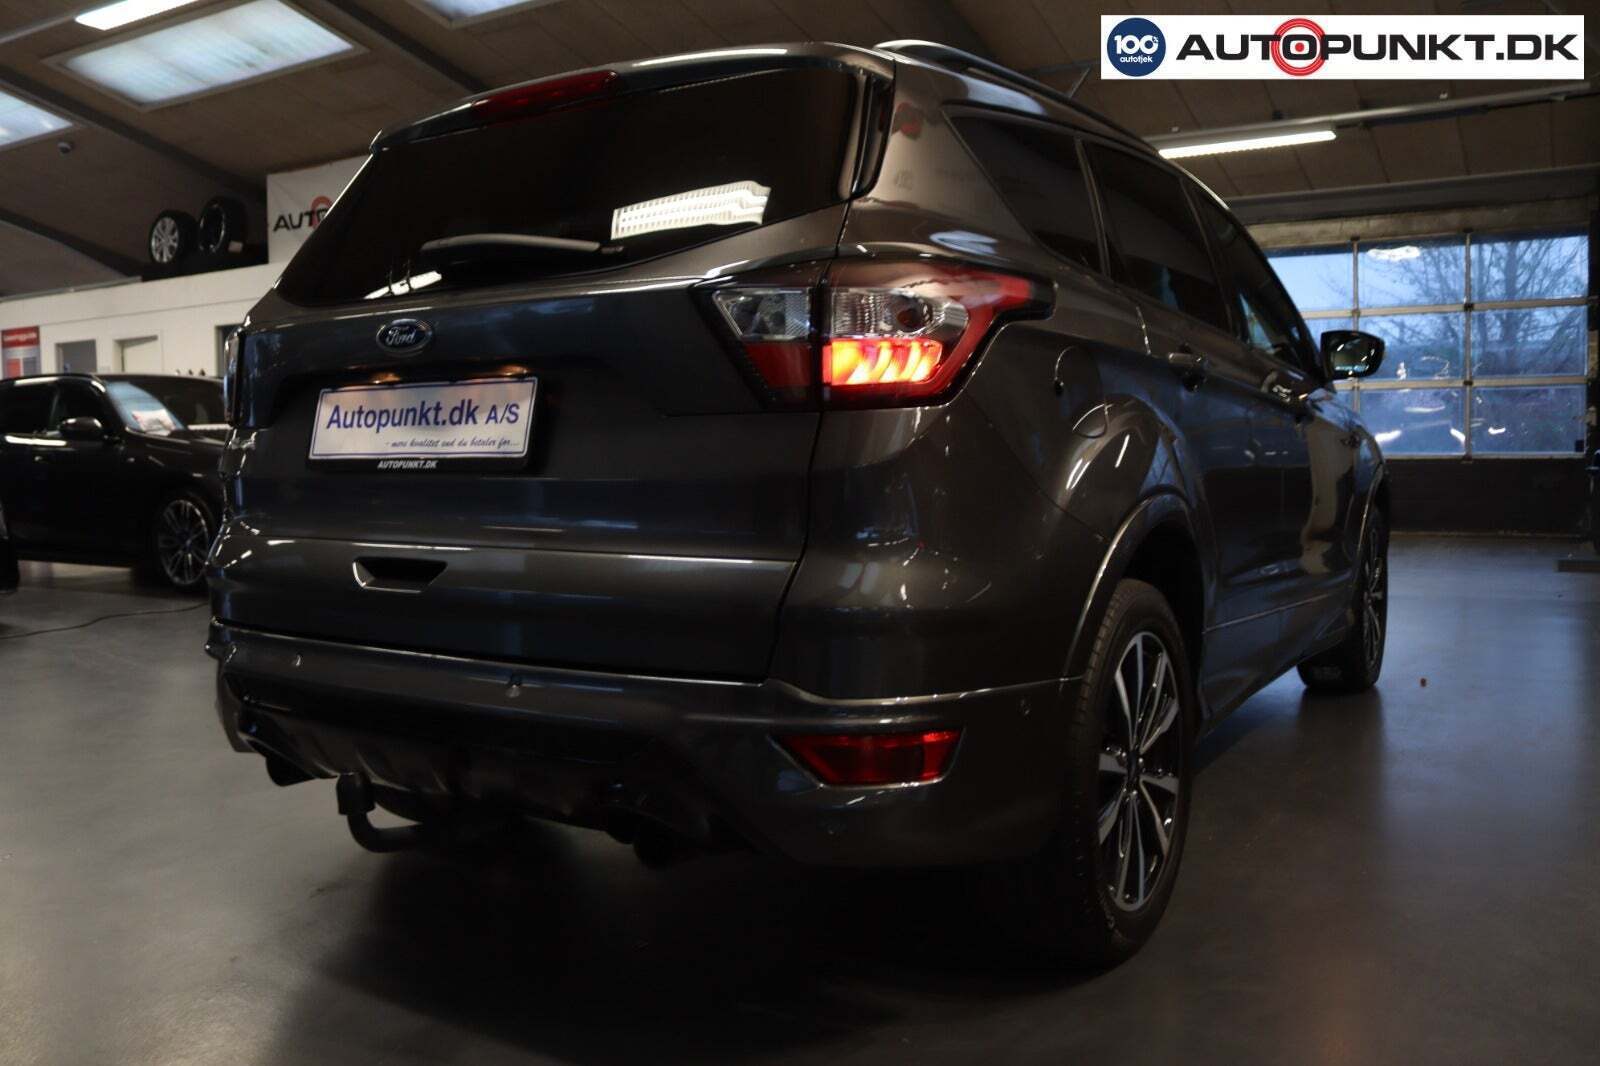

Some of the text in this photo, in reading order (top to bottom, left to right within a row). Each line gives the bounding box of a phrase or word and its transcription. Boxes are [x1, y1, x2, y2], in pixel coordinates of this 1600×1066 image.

[385, 326, 417, 346] Ford
[326, 398, 520, 434] Autopunkt.dk A/S
[377, 460, 438, 469] AUTOPUNKT.DK
